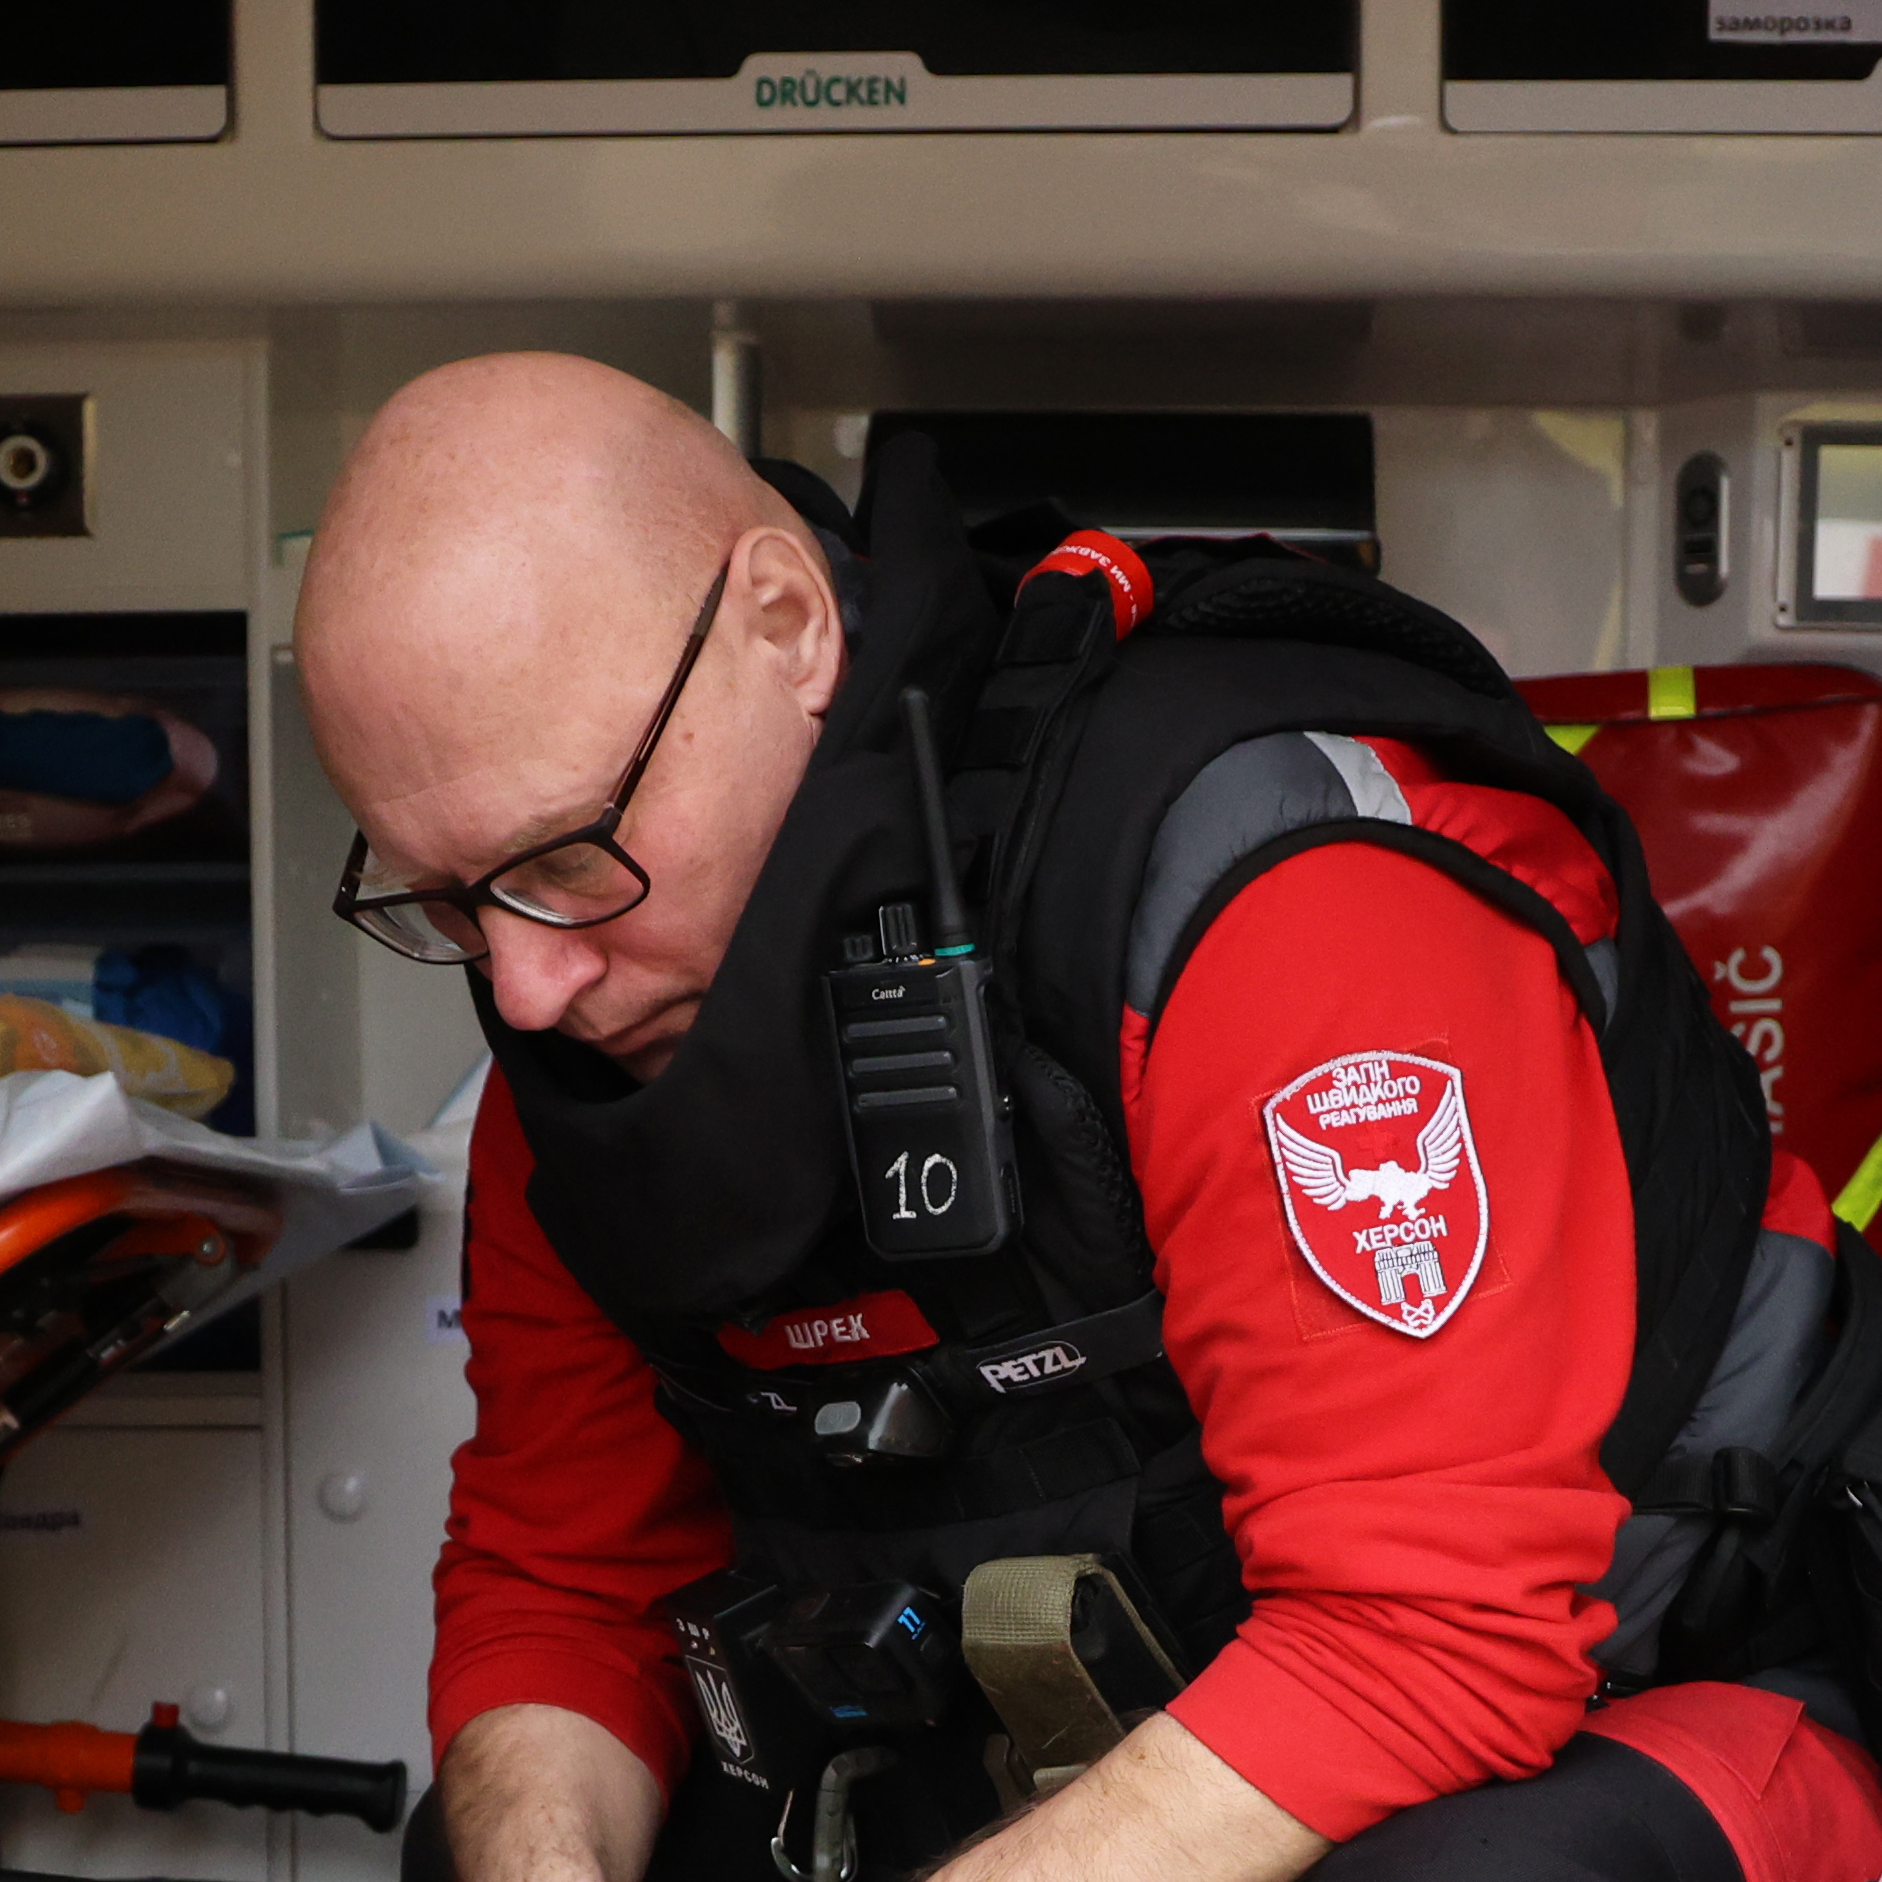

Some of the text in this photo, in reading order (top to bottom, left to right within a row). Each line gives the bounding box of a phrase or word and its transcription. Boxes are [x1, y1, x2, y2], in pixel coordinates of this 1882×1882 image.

[1714, 15, 1852, 36] заморозка
[754, 69, 908, 109] DRÜCKEN
[1305, 1075, 1422, 1114] ШВИДКОГО
[1318, 1098, 1419, 1130] РЕАГУВАННЯ
[882, 1150, 959, 1221] 10
[1352, 1215, 1448, 1254] ХЕРСОН
[783, 1313, 872, 1350] ШРЕК
[976, 1345, 1087, 1394] PETZL
[720, 1760, 770, 1791] ХЕРСОН
